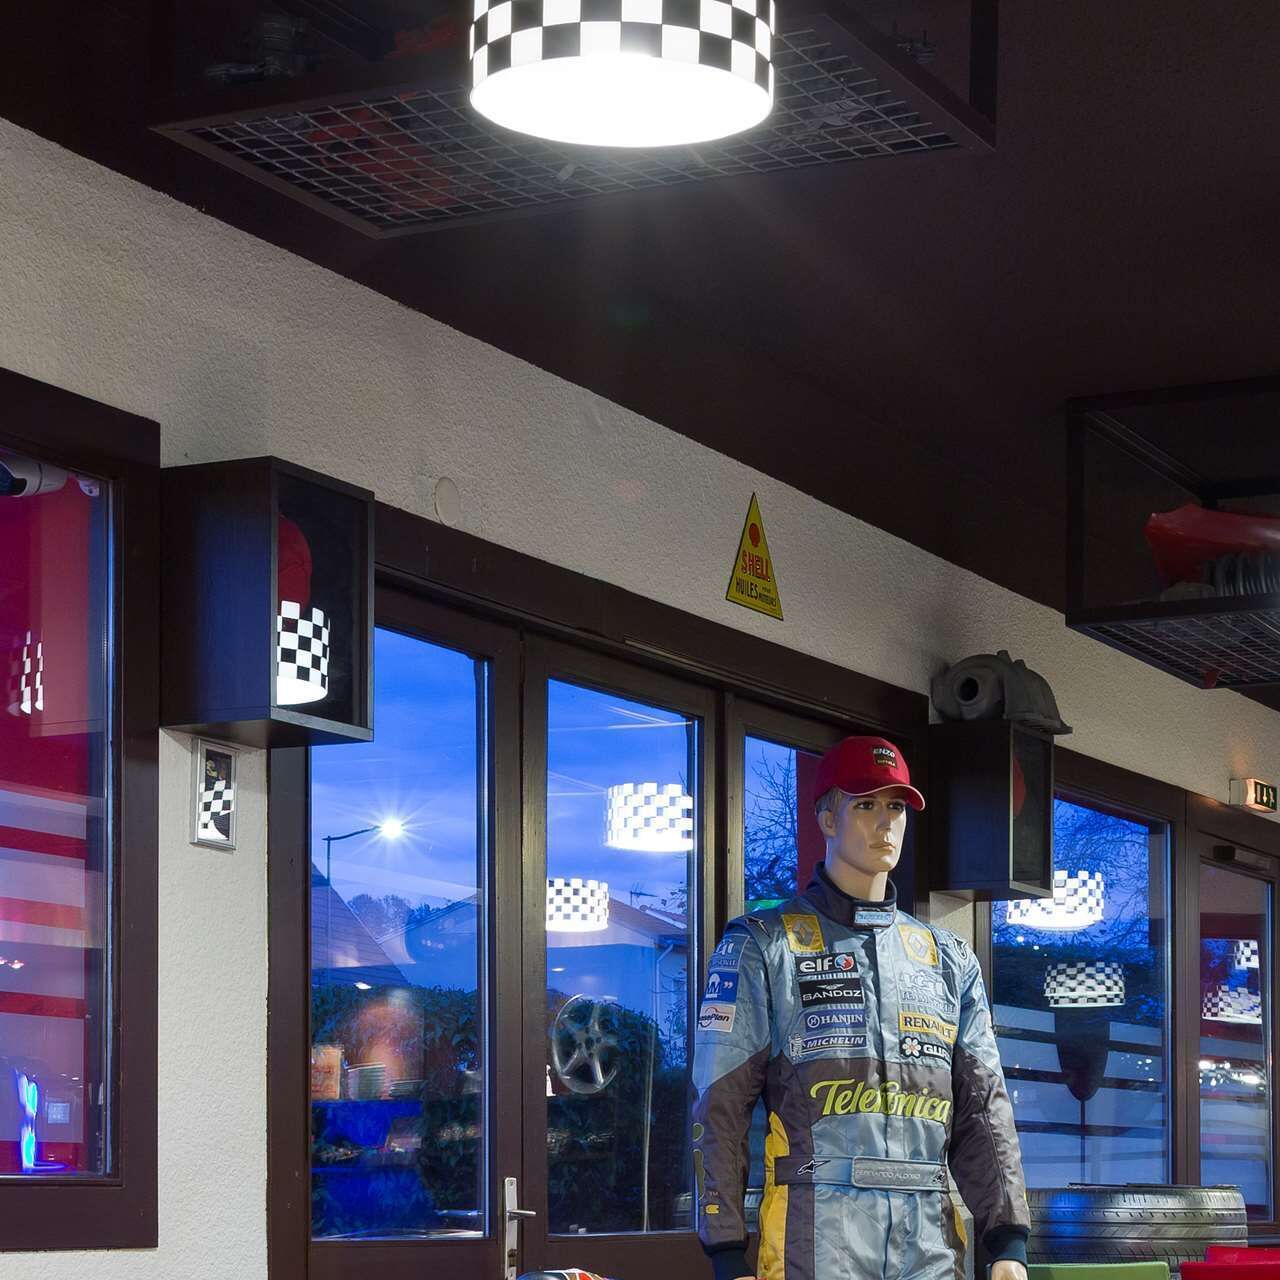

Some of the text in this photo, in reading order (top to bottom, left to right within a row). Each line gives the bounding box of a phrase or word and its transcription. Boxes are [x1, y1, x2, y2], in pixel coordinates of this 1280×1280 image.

[741, 550, 770, 582] SHELL
[799, 957, 833, 973] elf
[802, 989, 863, 1001] SANDOZ
[821, 1014, 863, 1025] HANJIN
[904, 1016, 954, 1039] RENAULT
[806, 1037, 864, 1048] MICHELIN
